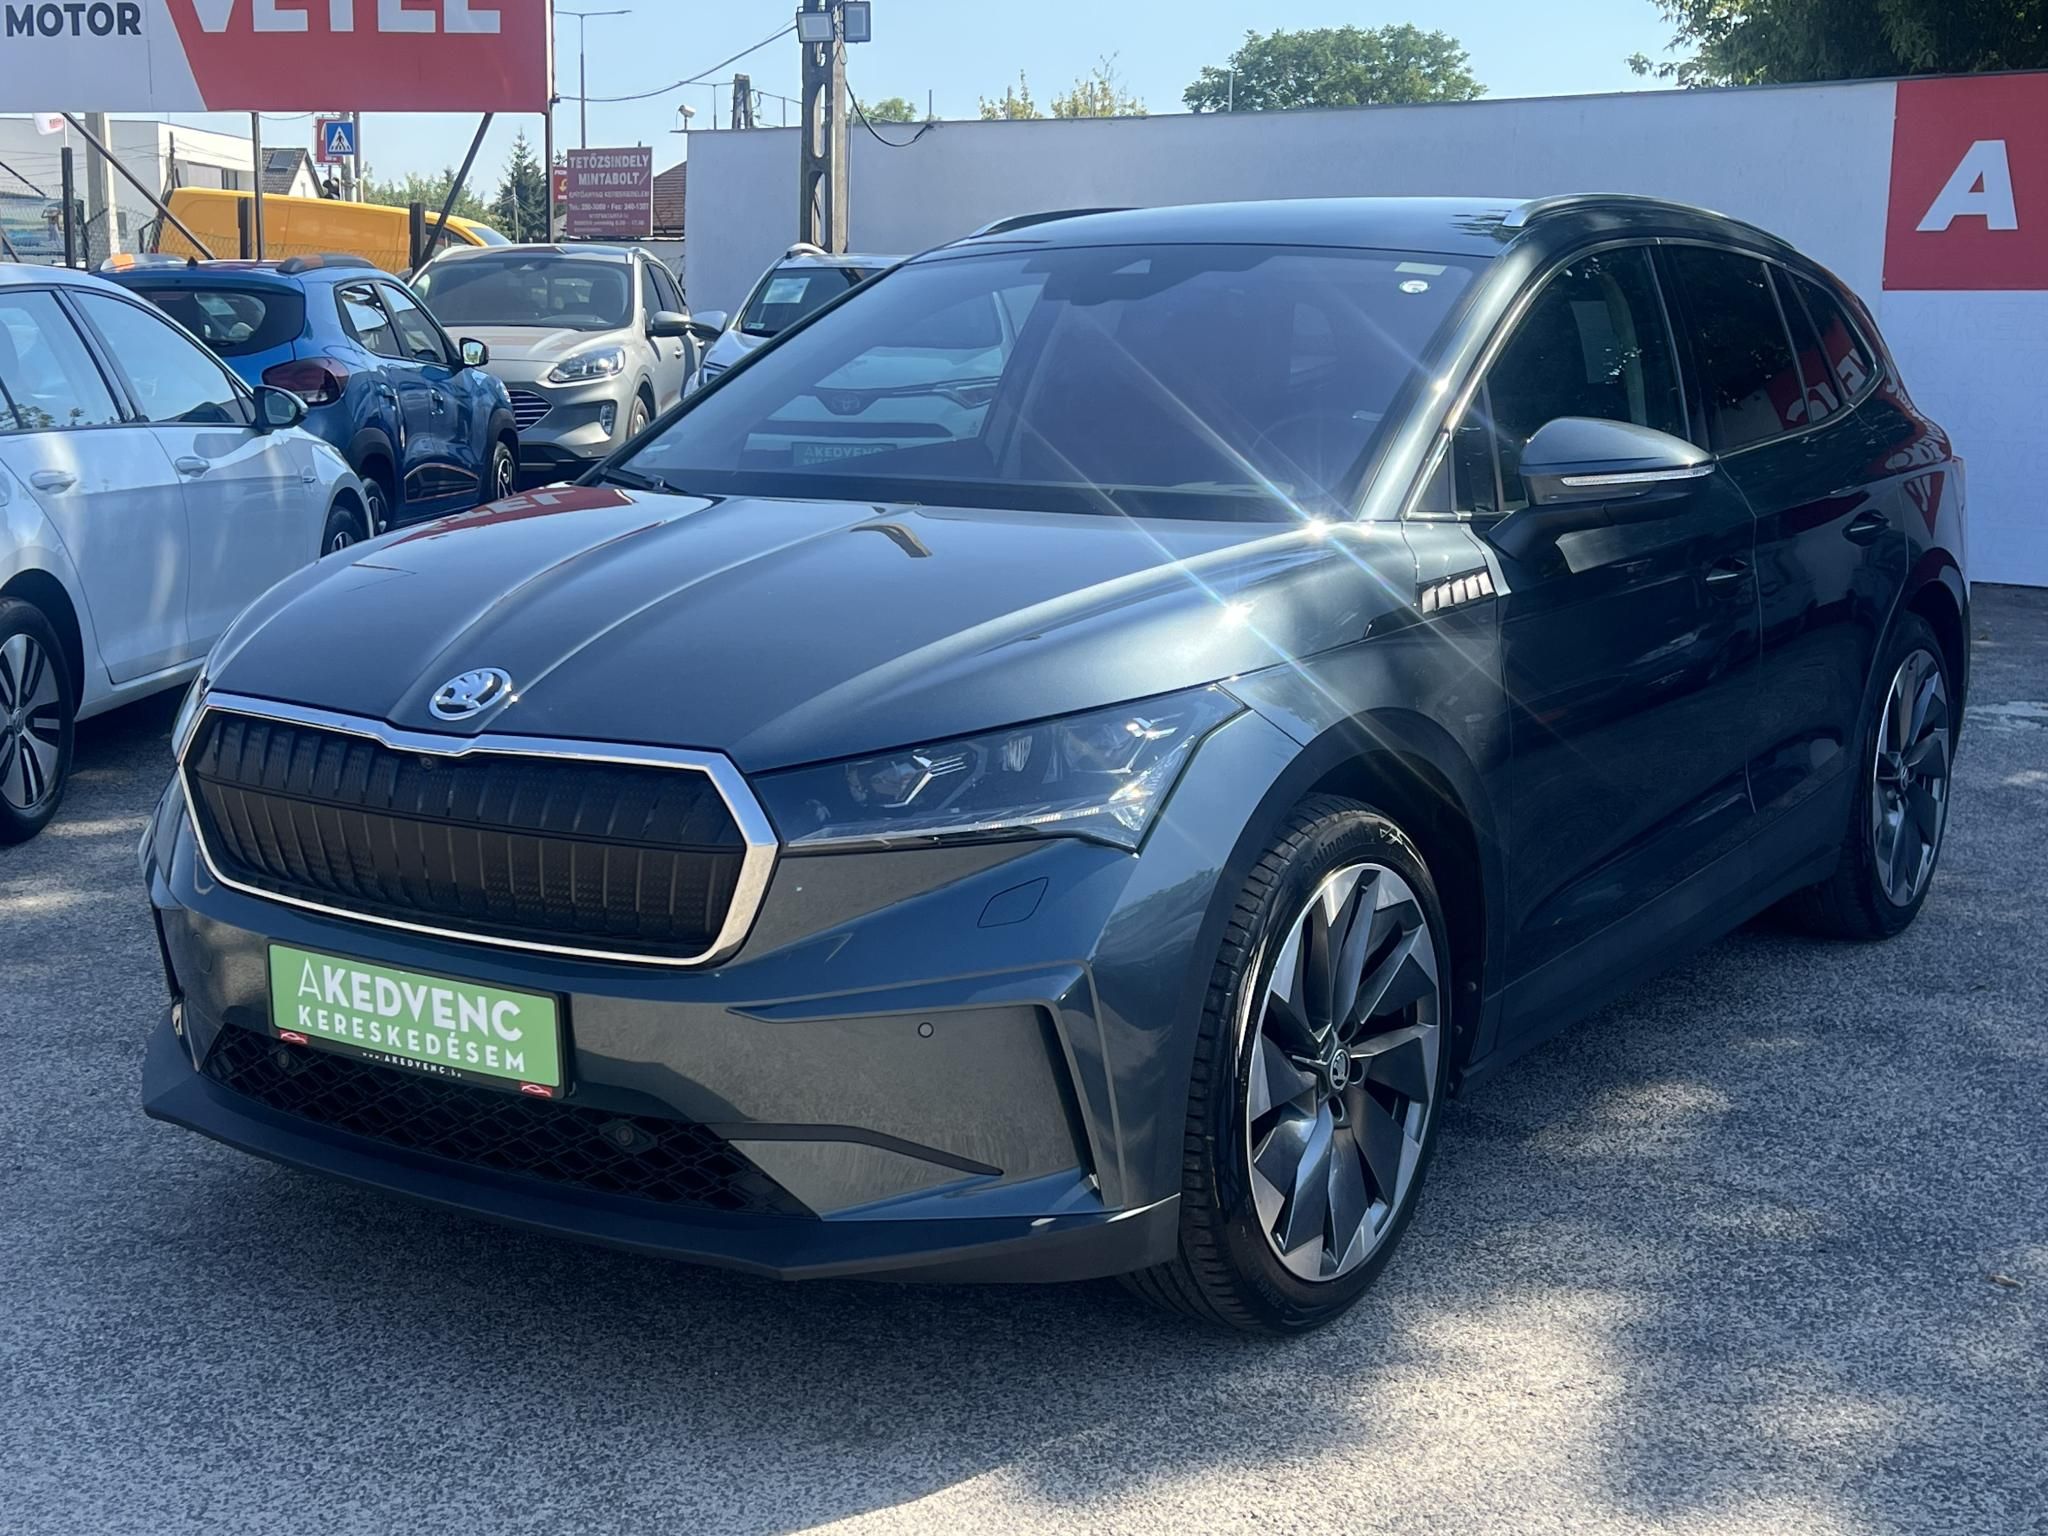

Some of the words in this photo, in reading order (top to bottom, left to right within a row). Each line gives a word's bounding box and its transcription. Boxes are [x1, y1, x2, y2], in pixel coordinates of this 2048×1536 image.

[5, 2, 142, 37] MOTOR
[578, 171, 640, 185] MINTABOLT
[297, 957, 523, 1041] AKEDVENC
[298, 1004, 525, 1073] KERESKEDÉSEM
